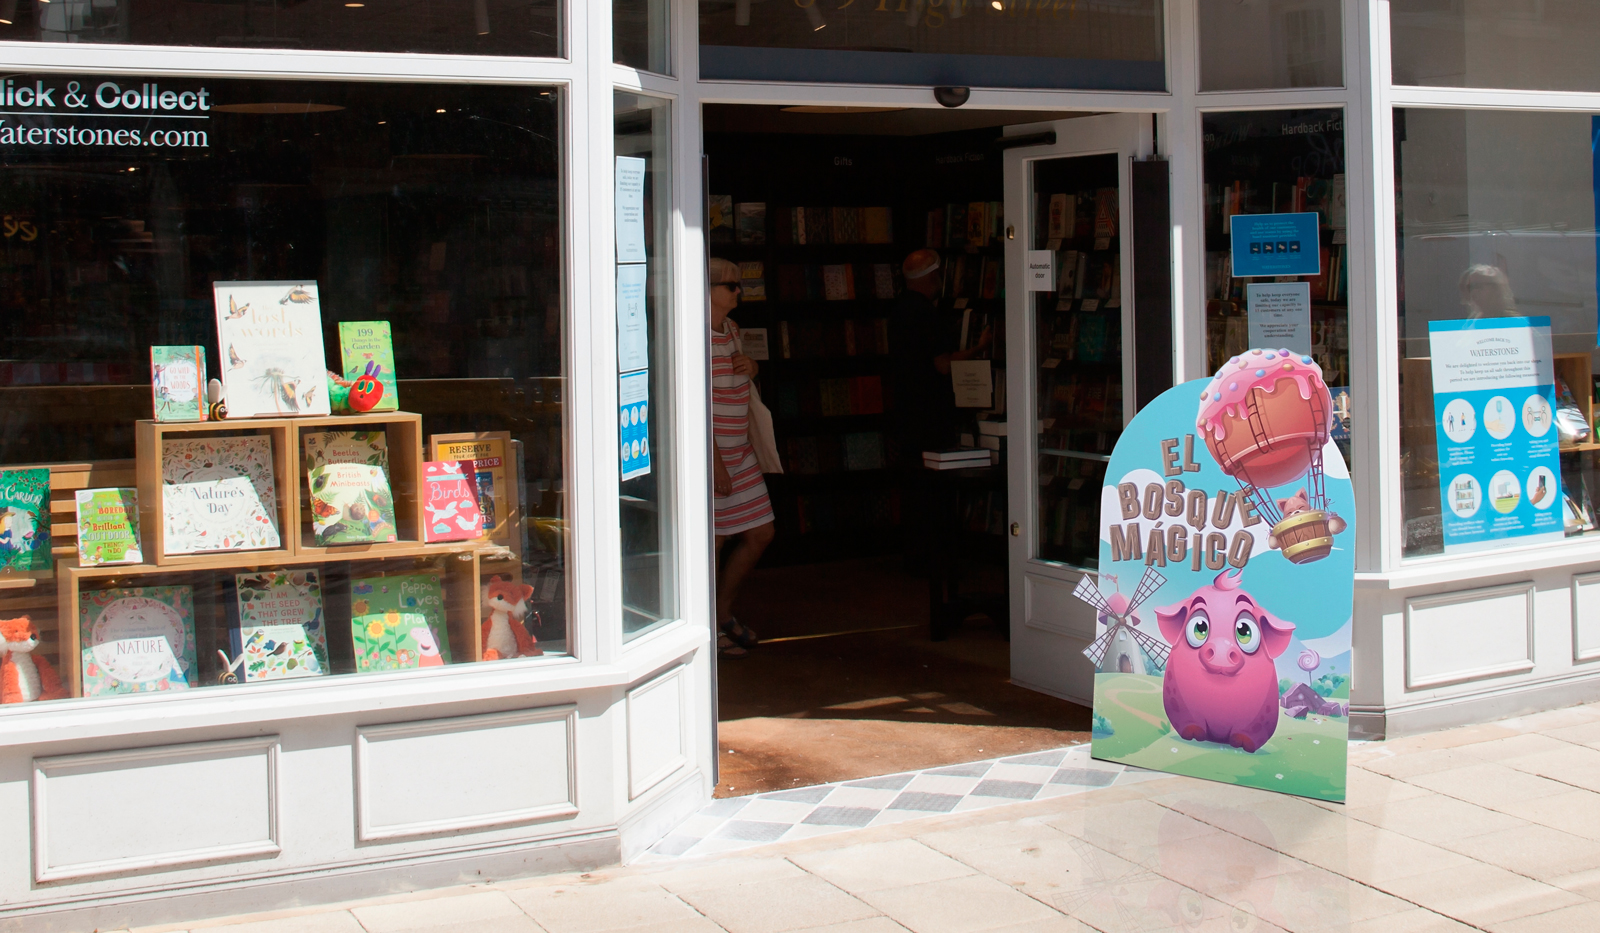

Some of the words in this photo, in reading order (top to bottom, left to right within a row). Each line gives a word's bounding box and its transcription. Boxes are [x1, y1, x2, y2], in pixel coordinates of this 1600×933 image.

[64, 81, 88, 108] &
[95, 81, 210, 110] Collect
[1281, 121, 1325, 135] Hardback
[251, 307, 285, 324] lost
[241, 321, 303, 338] words
[357, 328, 374, 337] 199
[352, 342, 381, 350] Garden
[1476, 337, 1495, 345] WELCOME
[1470, 347, 1519, 357] WATERSTONES
[169, 366, 176, 374] GO
[178, 366, 190, 374] WILD
[170, 380, 191, 390] WOODS
[449, 443, 492, 454] RESERVE
[328, 456, 368, 465] Butterflies
[1160, 433, 1201, 477] EL
[473, 457, 500, 469] PRICE
[337, 470, 362, 479] British
[330, 479, 370, 488] Minibeasts
[191, 486, 245, 500] Nature's
[429, 479, 470, 502] Birds
[207, 502, 233, 516] Day
[1117, 479, 1262, 532] BOSQUE
[88, 530, 131, 542] OUTDOOR
[1109, 521, 1255, 573] MÁGICO
[401, 581, 434, 595] Peppa
[276, 591, 288, 599] AM
[399, 592, 440, 609] Loves
[260, 600, 277, 610] THE
[279, 599, 301, 608] SEED
[258, 609, 278, 619] THAT
[280, 608, 305, 618] GREW
[414, 607, 429, 615] Our
[262, 618, 279, 627] THE
[281, 617, 302, 626] TREE
[404, 611, 440, 626] Planet
[117, 639, 164, 655] NATURE
